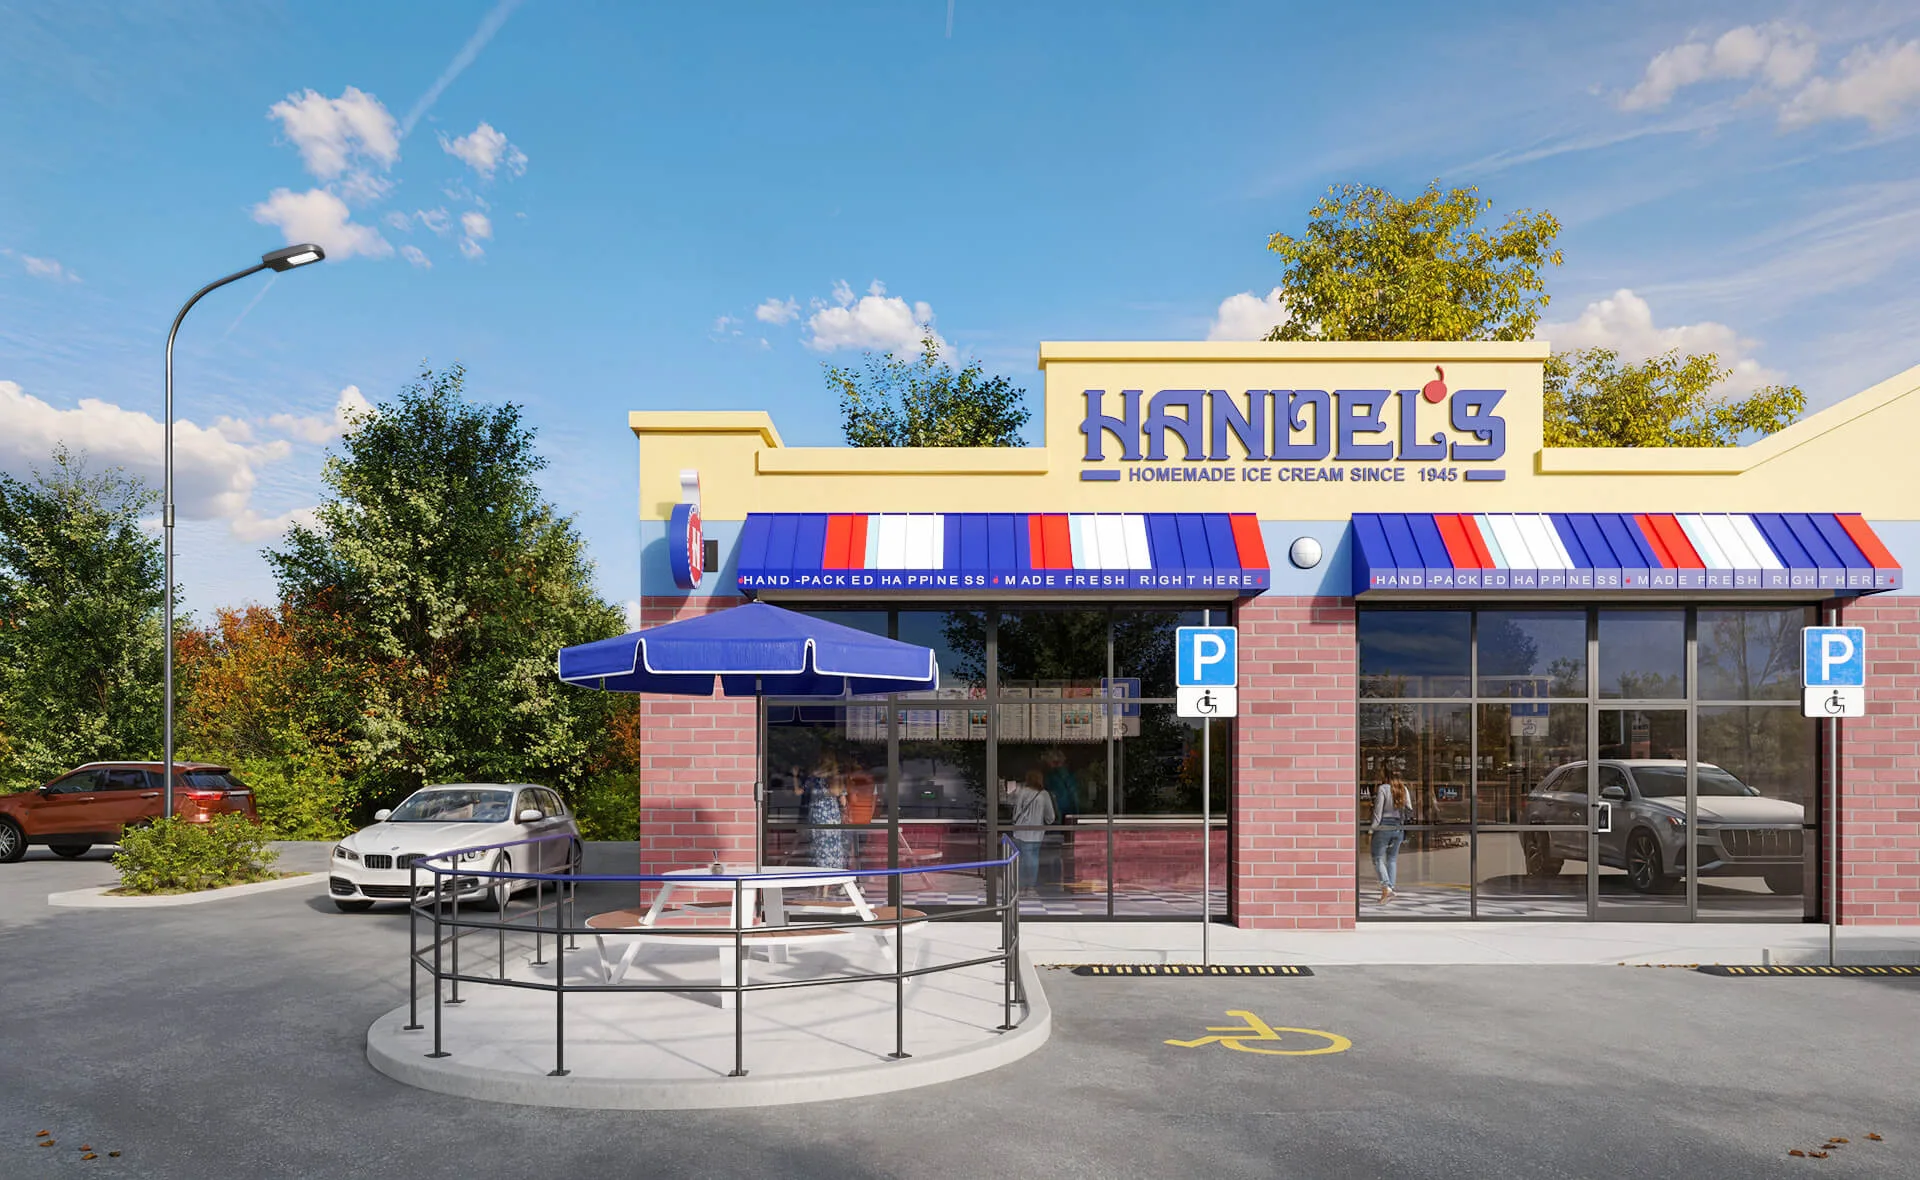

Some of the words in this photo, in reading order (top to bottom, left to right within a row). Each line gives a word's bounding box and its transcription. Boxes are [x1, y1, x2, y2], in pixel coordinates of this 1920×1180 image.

[1128, 467, 1236, 482] HOMEMADE
[1241, 467, 1272, 482] ICE
[1277, 467, 1344, 482] CREAM
[1349, 467, 1405, 482] SINCE
[1416, 467, 1458, 482] 1945
[881, 575, 985, 585] HAPPINESS
[1004, 575, 1055, 585] MADE
[1065, 575, 1125, 585] FRESH
[1140, 575, 1197, 585] RIGHT
[1203, 575, 1252, 585] HERE
[1514, 575, 1618, 585] HAPPINESS
[1637, 575, 1688, 585] MADE
[1698, 575, 1757, 585] FRESH
[1773, 575, 1828, 585] RIGHT
[1835, 575, 1884, 585] HERE
[1193, 633, 1226, 681] P
[1821, 633, 1854, 681] P
